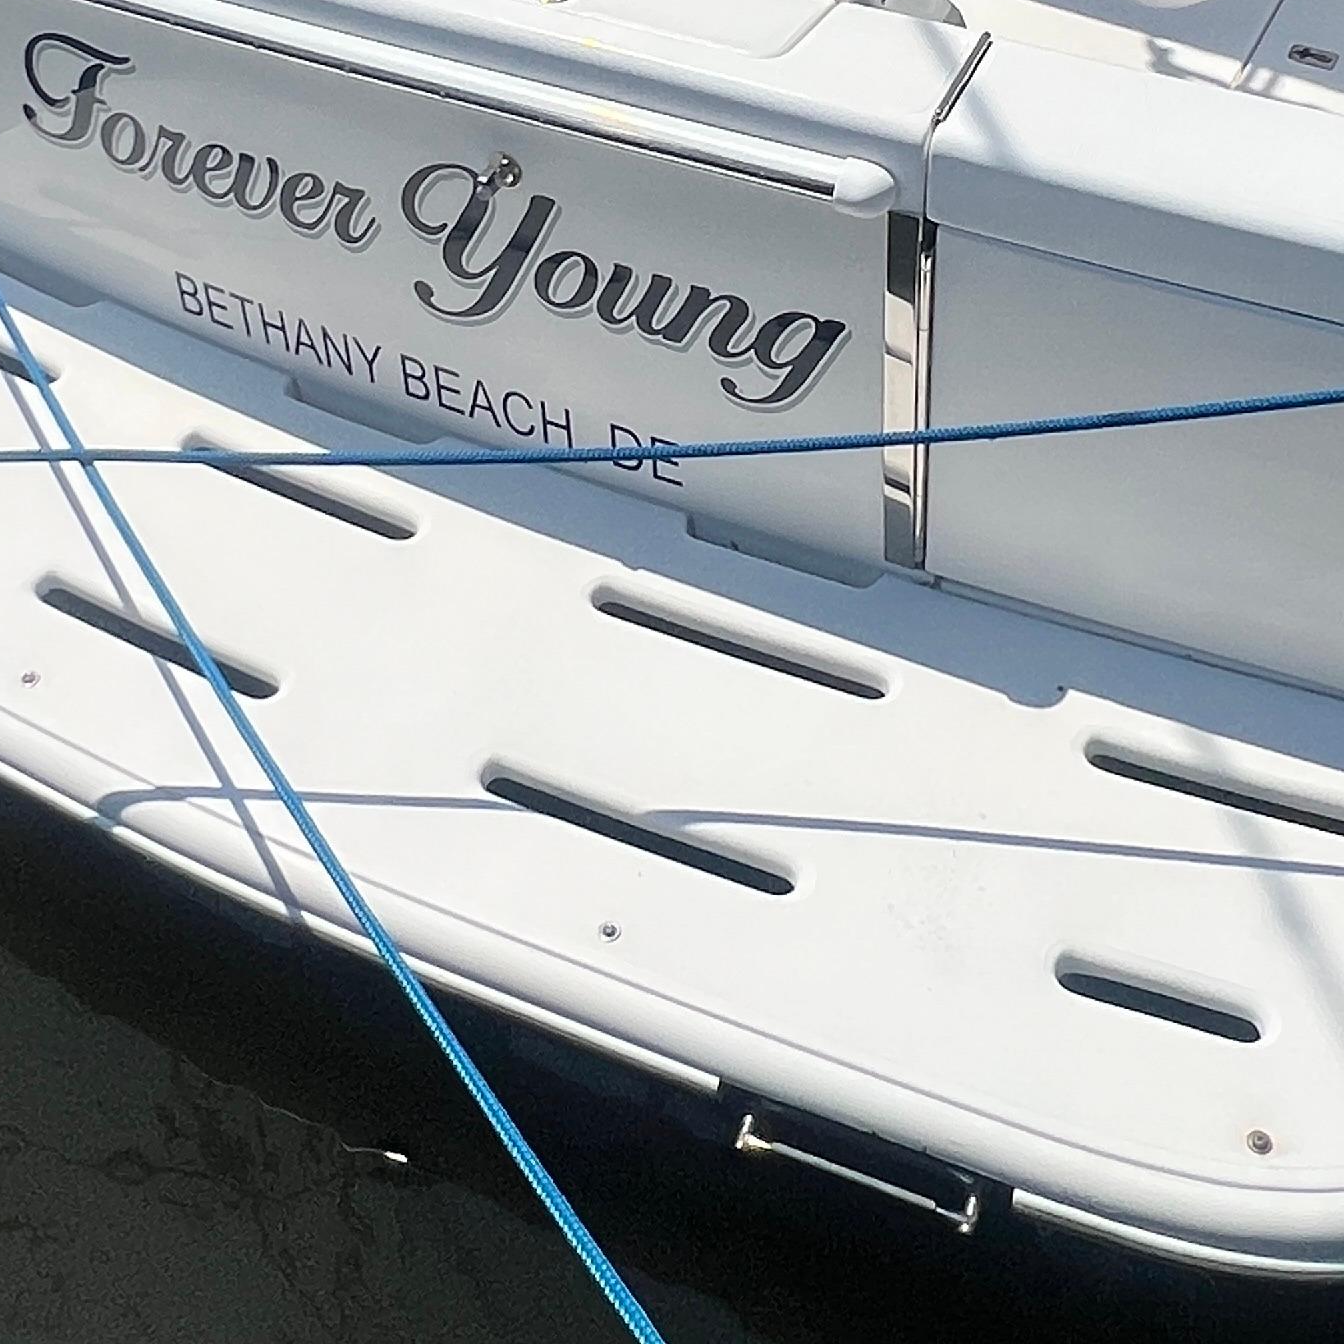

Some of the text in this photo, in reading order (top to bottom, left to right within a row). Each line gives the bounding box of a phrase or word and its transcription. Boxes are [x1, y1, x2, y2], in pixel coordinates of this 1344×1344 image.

[23, 32, 851, 412] Forever Young
[175, 271, 382, 384] BETHANY
[610, 423, 683, 487] DE
